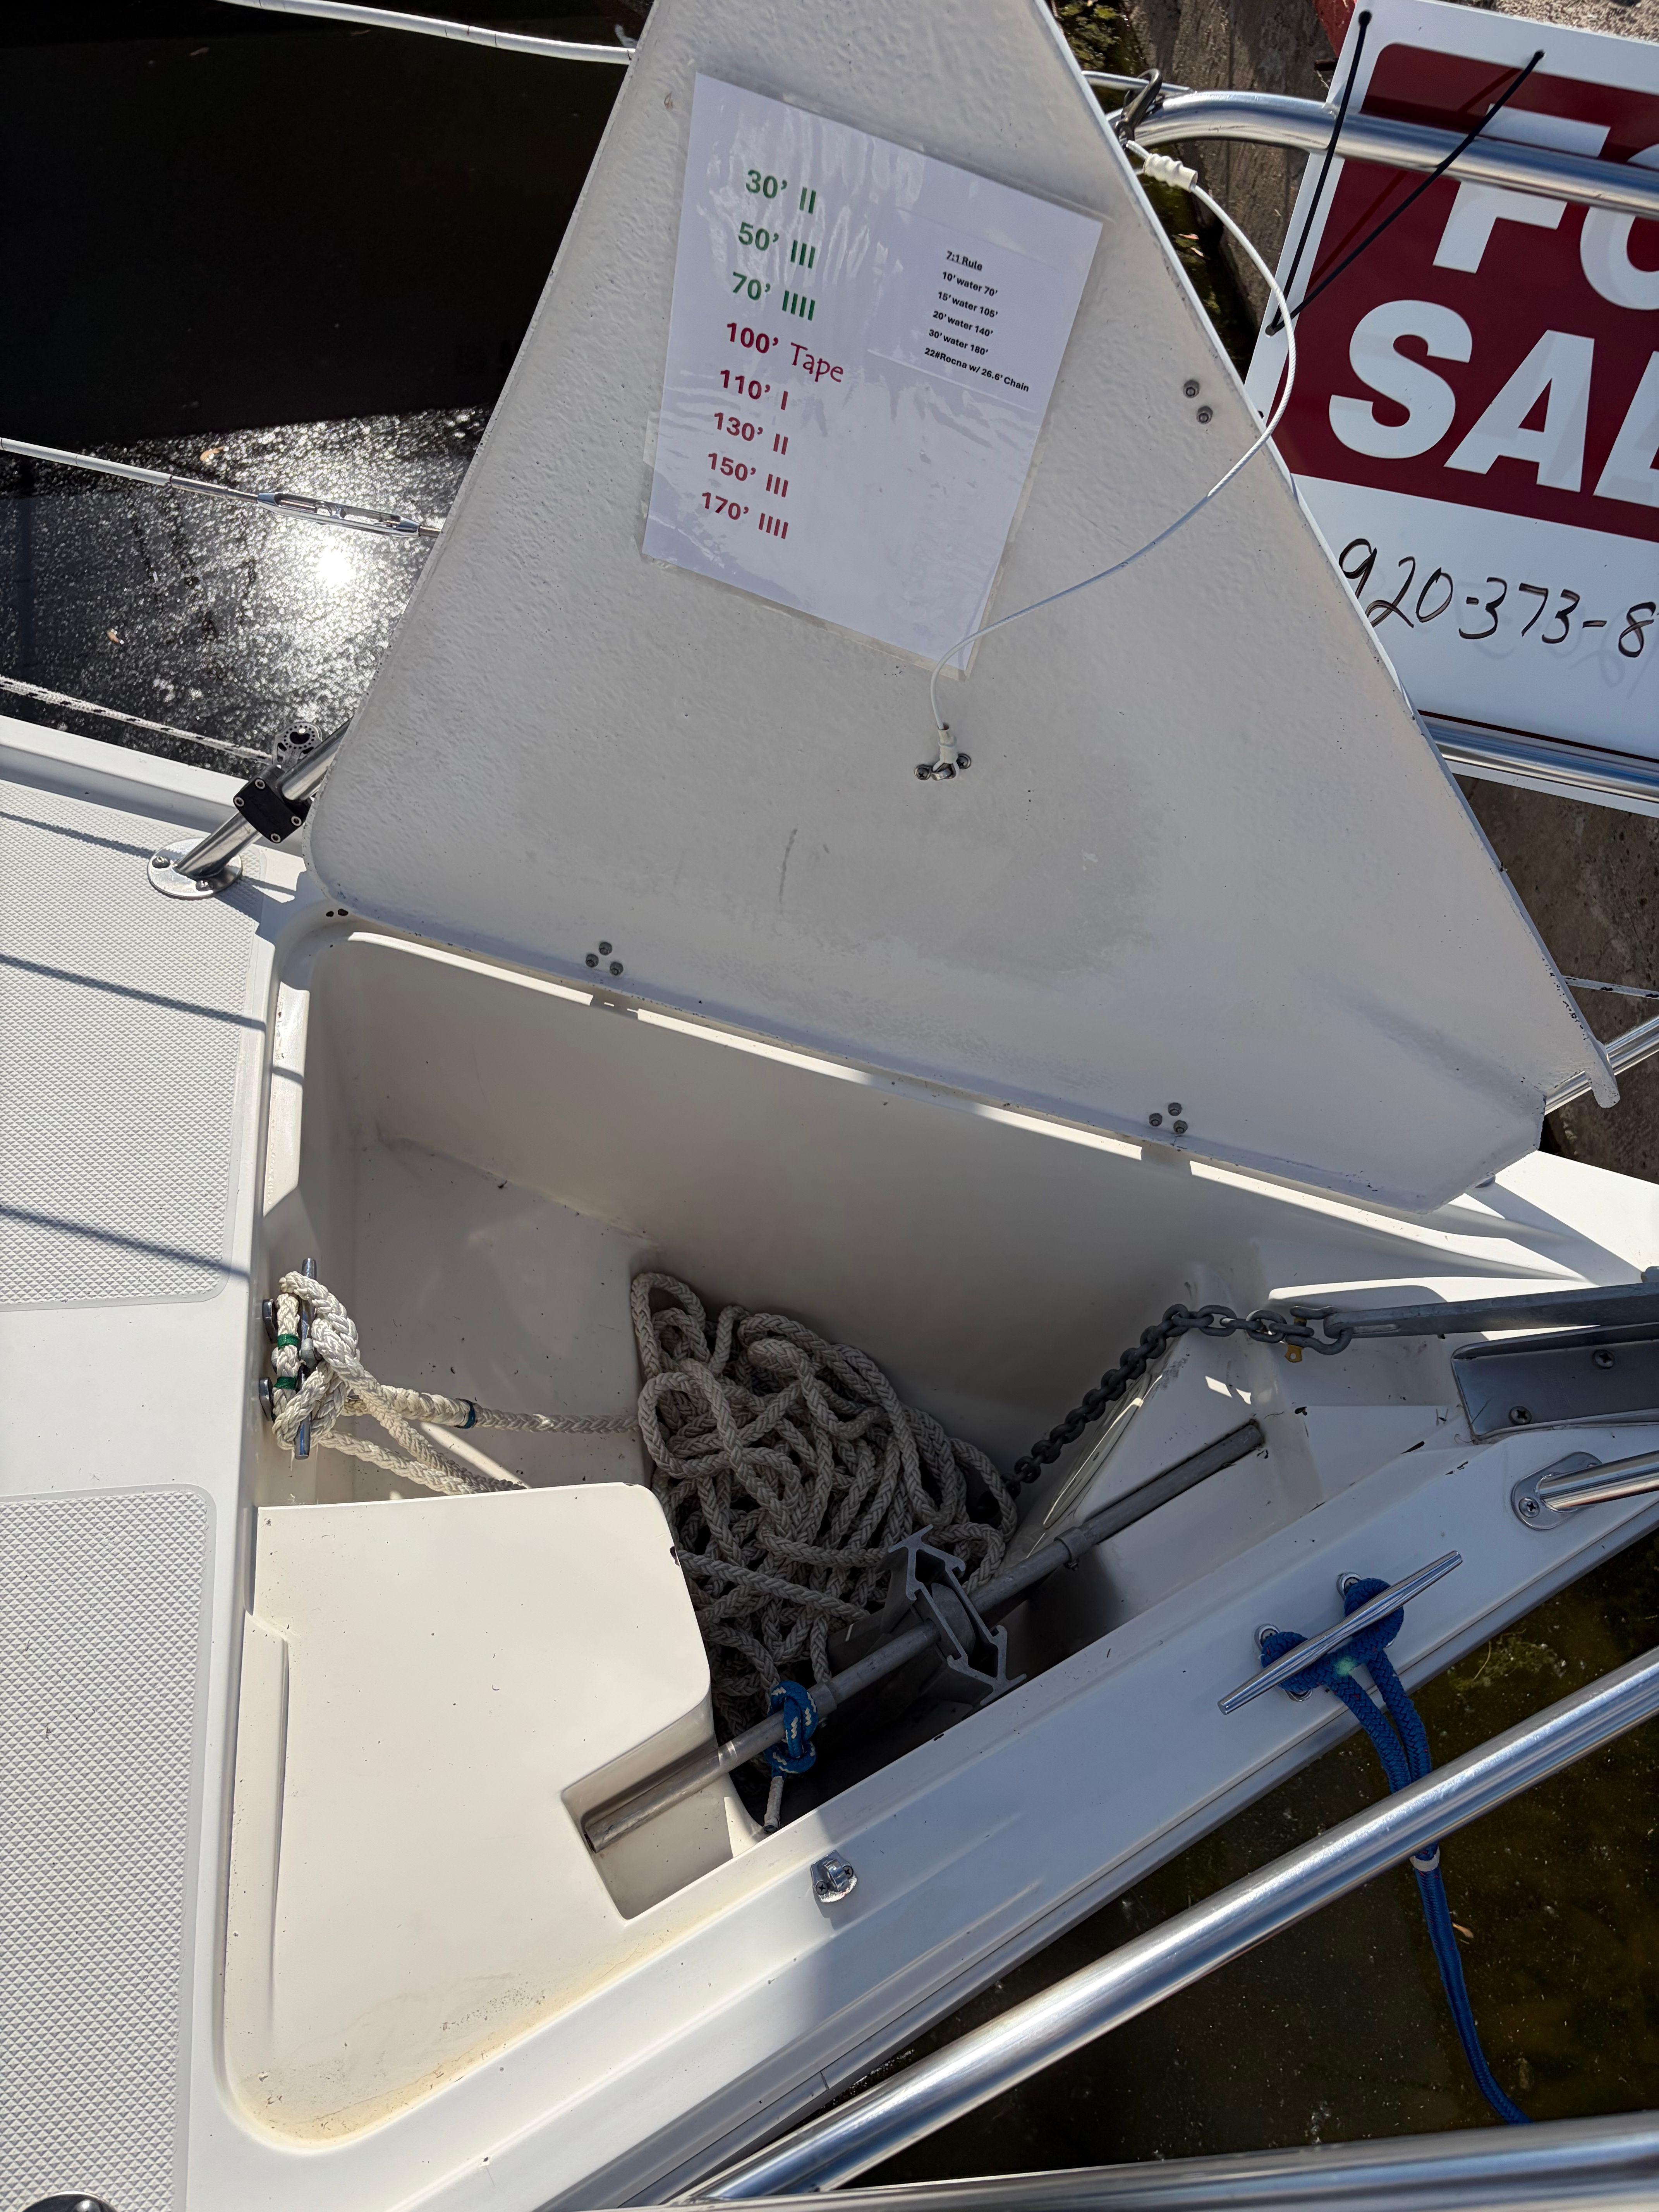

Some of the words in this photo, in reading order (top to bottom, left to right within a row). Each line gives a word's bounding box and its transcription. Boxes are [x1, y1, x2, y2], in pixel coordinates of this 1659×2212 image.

[746, 170, 788, 199] 30'
[738, 222, 779, 251] 50'
[946, 251, 961, 264] 7:1
[962, 257, 982, 271] Rule
[733, 271, 771, 301] 70'
[943, 271, 955, 281] 10'
[956, 277, 982, 292] water
[984, 286, 998, 296] 70'
[938, 291, 951, 301] 15'
[952, 297, 977, 311] water
[980, 306, 998, 317] 105'
[933, 311, 946, 320] 20'
[948, 316, 973, 330] water
[975, 326, 993, 336] 140'
[727, 322, 778, 354] 100'
[790, 342, 843, 383] Tape
[929, 329, 942, 338] 30'
[943, 335, 968, 349] water
[970, 344, 988, 355] 180'
[720, 369, 770, 400] 110'
[969, 364, 980, 373] w/
[981, 368, 1003, 381] 26.6'
[1004, 377, 1029, 392] Chain
[714, 412, 763, 441] 130'
[708, 453, 756, 481] 150'
[702, 492, 749, 520] 170'
